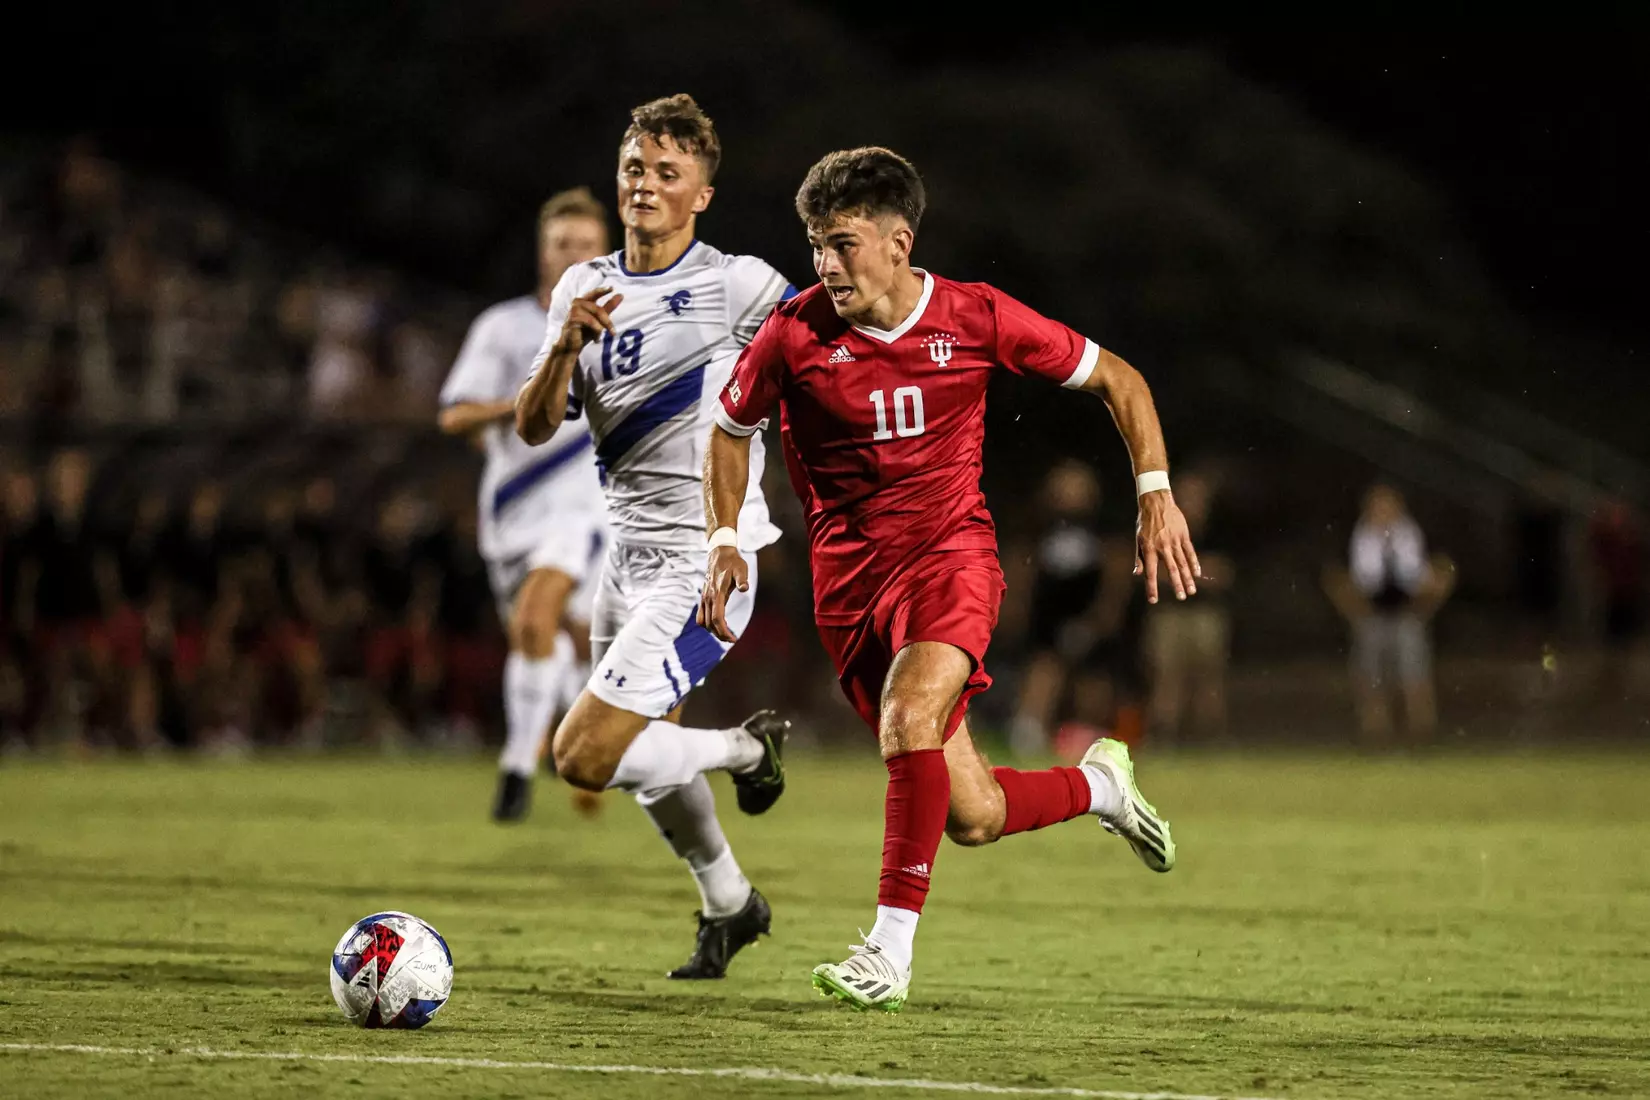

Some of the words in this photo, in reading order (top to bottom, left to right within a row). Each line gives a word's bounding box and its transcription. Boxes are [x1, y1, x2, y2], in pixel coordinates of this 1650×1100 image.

[602, 328, 644, 381] 19
[828, 354, 856, 364] adidas
[869, 385, 925, 441] 10
